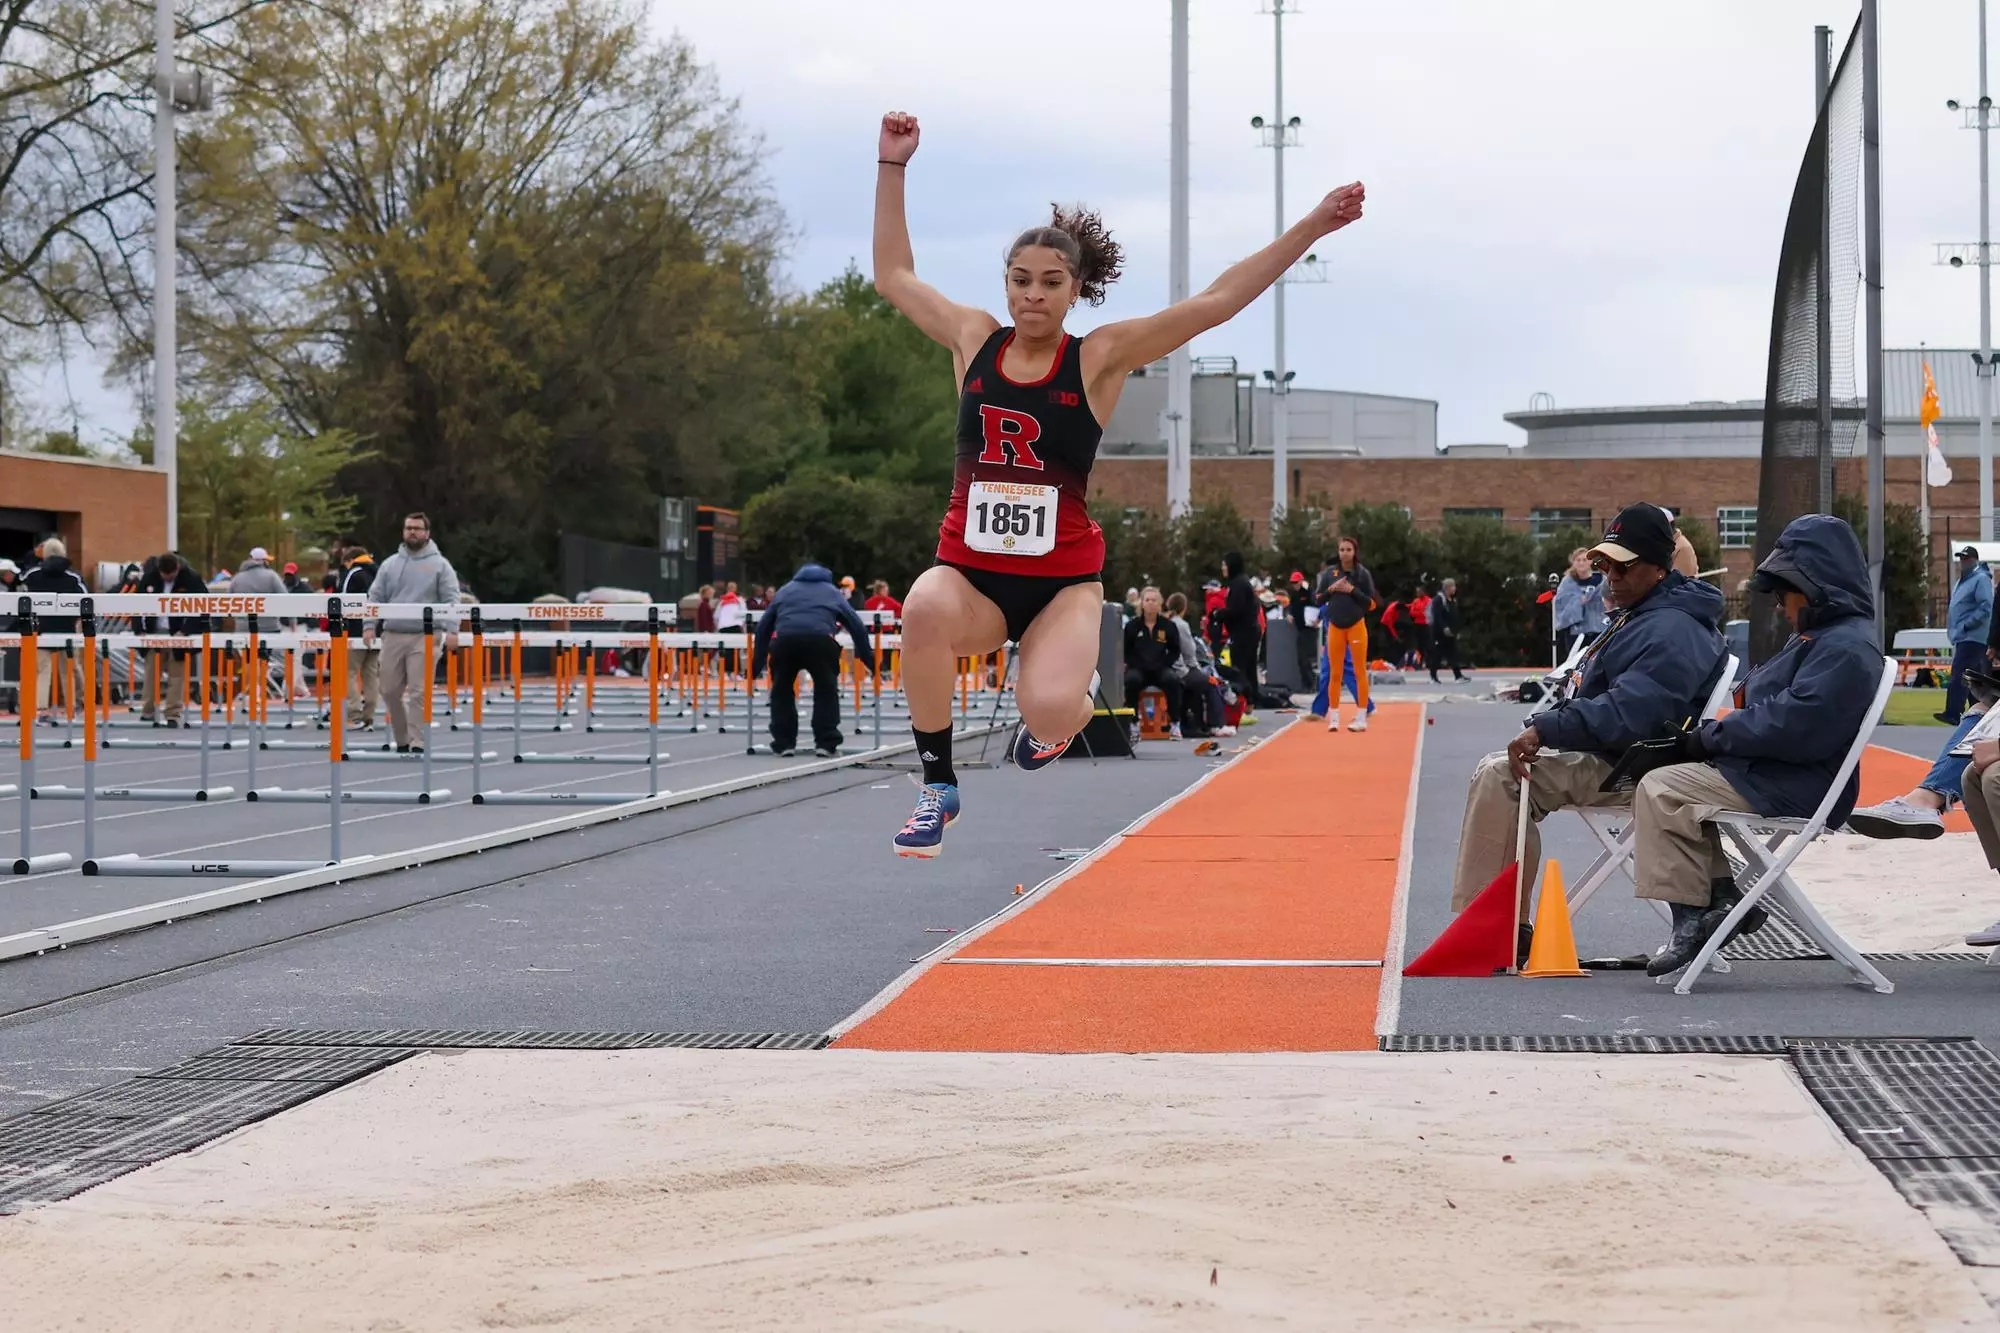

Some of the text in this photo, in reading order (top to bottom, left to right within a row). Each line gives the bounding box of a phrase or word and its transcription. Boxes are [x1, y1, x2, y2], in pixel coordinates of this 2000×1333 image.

[979, 404, 1043, 471] R
[982, 483, 1045, 496] TENNESSEE
[976, 502, 1046, 537] 1851
[158, 597, 265, 613] TENNESSEE
[527, 606, 604, 618] TENNESSEE
[191, 863, 230, 873] UCS
